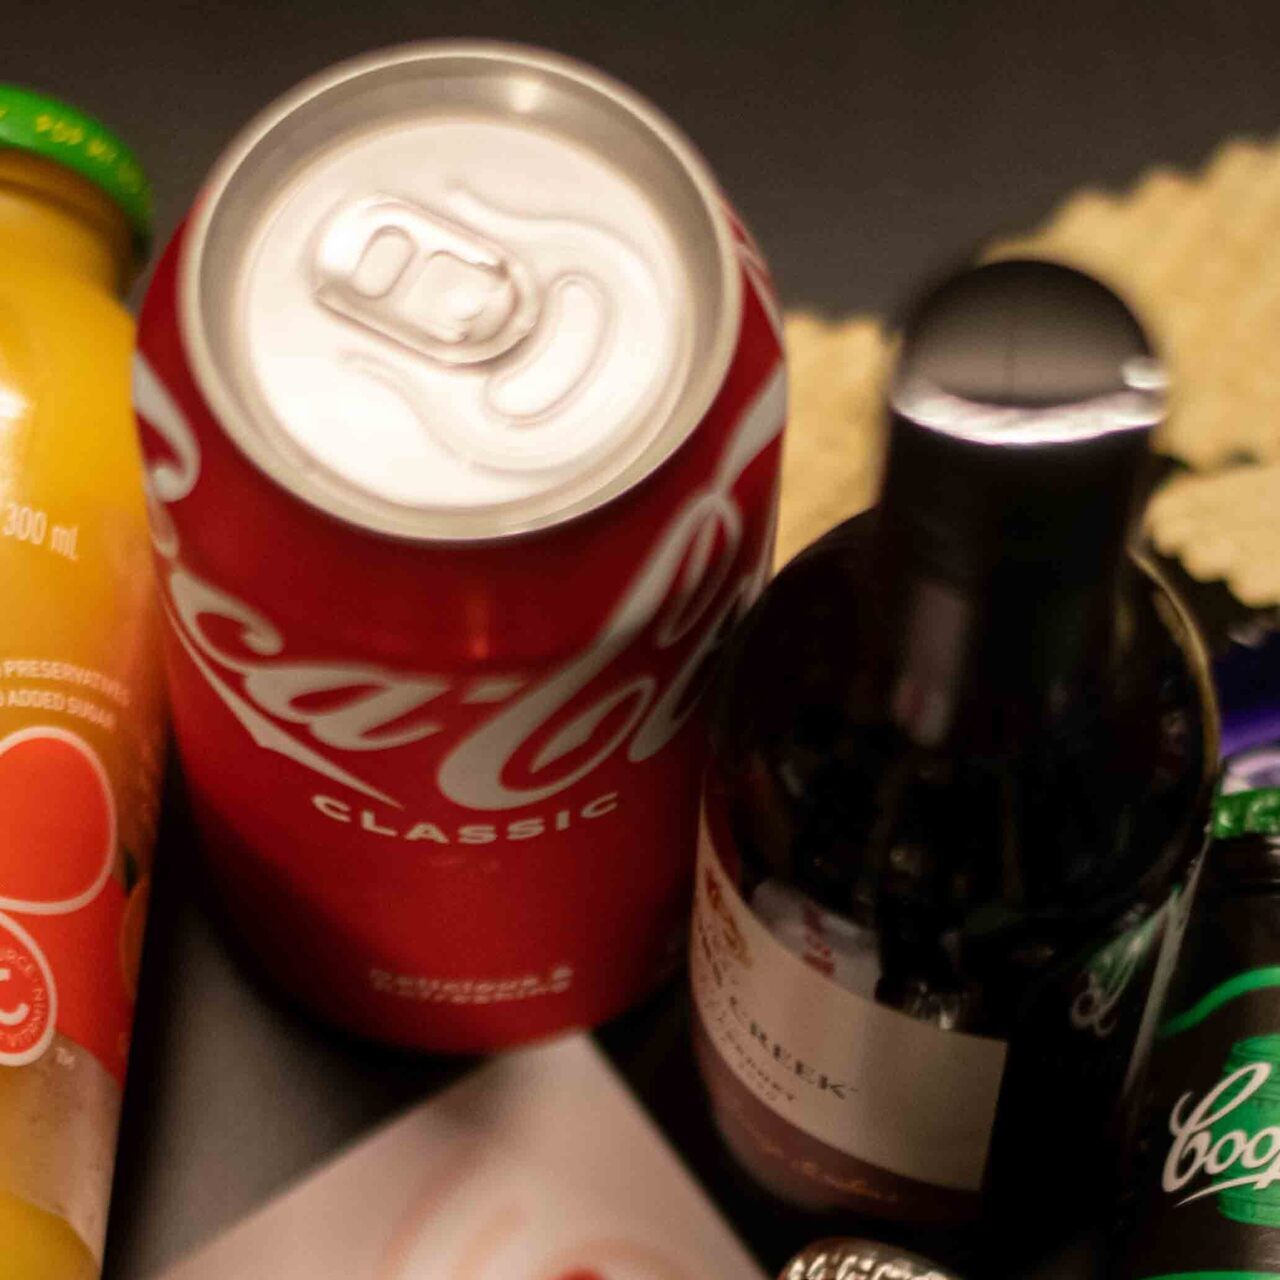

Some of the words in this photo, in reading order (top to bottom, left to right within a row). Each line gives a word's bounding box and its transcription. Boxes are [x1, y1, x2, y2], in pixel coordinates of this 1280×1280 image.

[3, 502, 46, 545] 300
[7, 688, 67, 711] ADDED
[66, 696, 117, 732] SUGAR
[311, 792, 619, 845] CLASSIC
